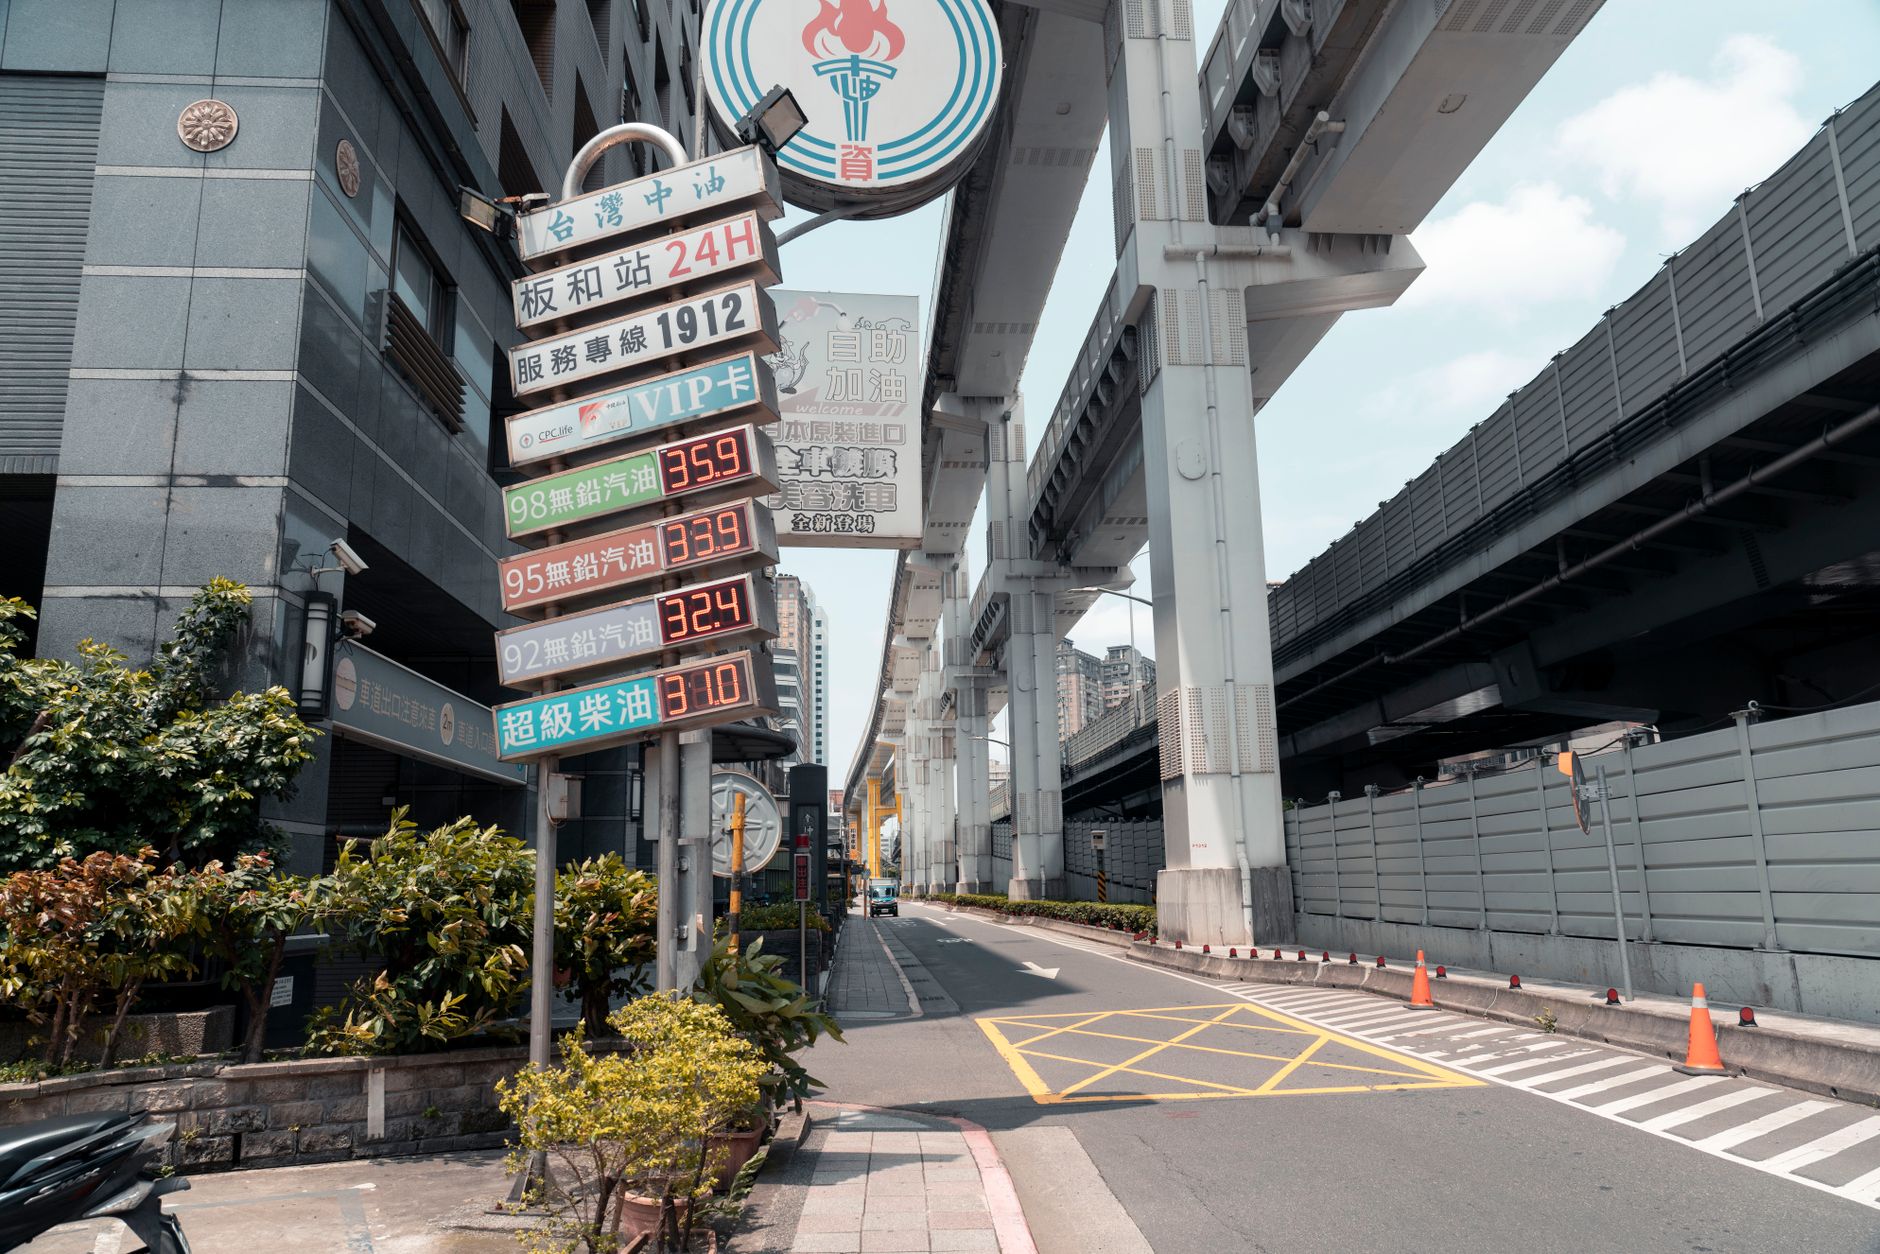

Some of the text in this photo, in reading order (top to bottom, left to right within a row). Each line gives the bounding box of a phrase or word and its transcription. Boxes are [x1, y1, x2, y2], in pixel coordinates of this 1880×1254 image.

[840, 144, 873, 182] 資
[547, 166, 725, 243] 台灣中油
[520, 219, 756, 319] 板和站 24H
[518, 292, 746, 385] 服務專線 1912
[827, 329, 907, 363] 自助
[795, 402, 863, 415] welcome
[826, 367, 907, 403] 加油
[666, 436, 741, 489] 35.9
[768, 479, 898, 512] 美容洗車
[666, 511, 741, 563] 33.9
[791, 513, 876, 533] 全新登場
[665, 587, 740, 638] 32.4
[502, 663, 741, 750] 超級柴油 31.0
